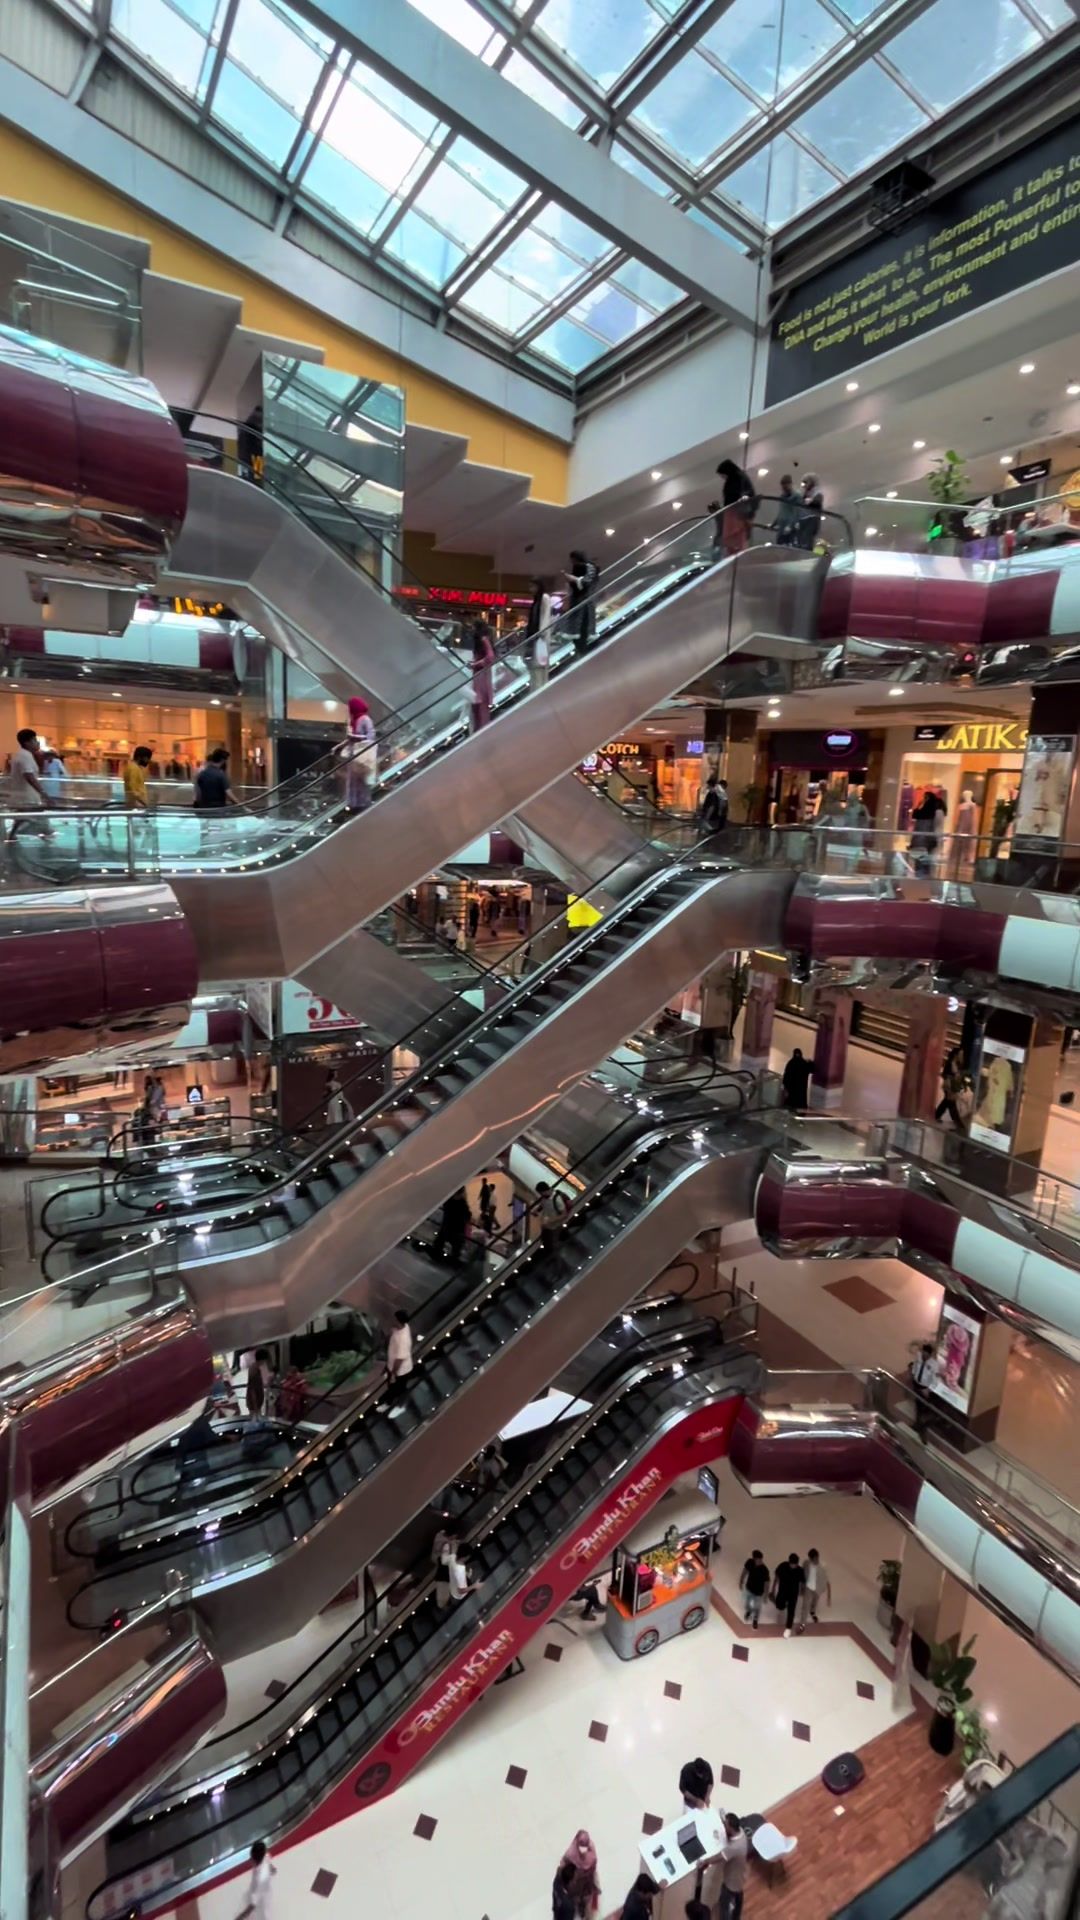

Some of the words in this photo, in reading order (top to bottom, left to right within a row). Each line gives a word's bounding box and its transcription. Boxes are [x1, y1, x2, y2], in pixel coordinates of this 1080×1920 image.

[778, 312, 803, 335] Food
[803, 308, 812, 321] is
[814, 297, 832, 315] not
[831, 284, 852, 309] just
[1013, 186, 1025, 203] it
[1027, 165, 1065, 195] talks
[806, 317, 827, 338] and
[860, 284, 887, 308] what
[891, 277, 905, 291] to
[929, 250, 953, 270] The
[955, 227, 991, 257] most
[993, 187, 1061, 237] Powerful
[813, 325, 852, 352] Change
[853, 310, 880, 335] your
[922, 241, 1007, 295] environment
[1009, 222, 1039, 250] and
[863, 318, 897, 346] World
[897, 313, 909, 328] is
[910, 299, 941, 326] your
[562, 1507, 621, 1567] Bundu
[617, 1467, 662, 1510] Khan
[400, 1676, 466, 1743] Bundu
[463, 1629, 513, 1677] Khan
